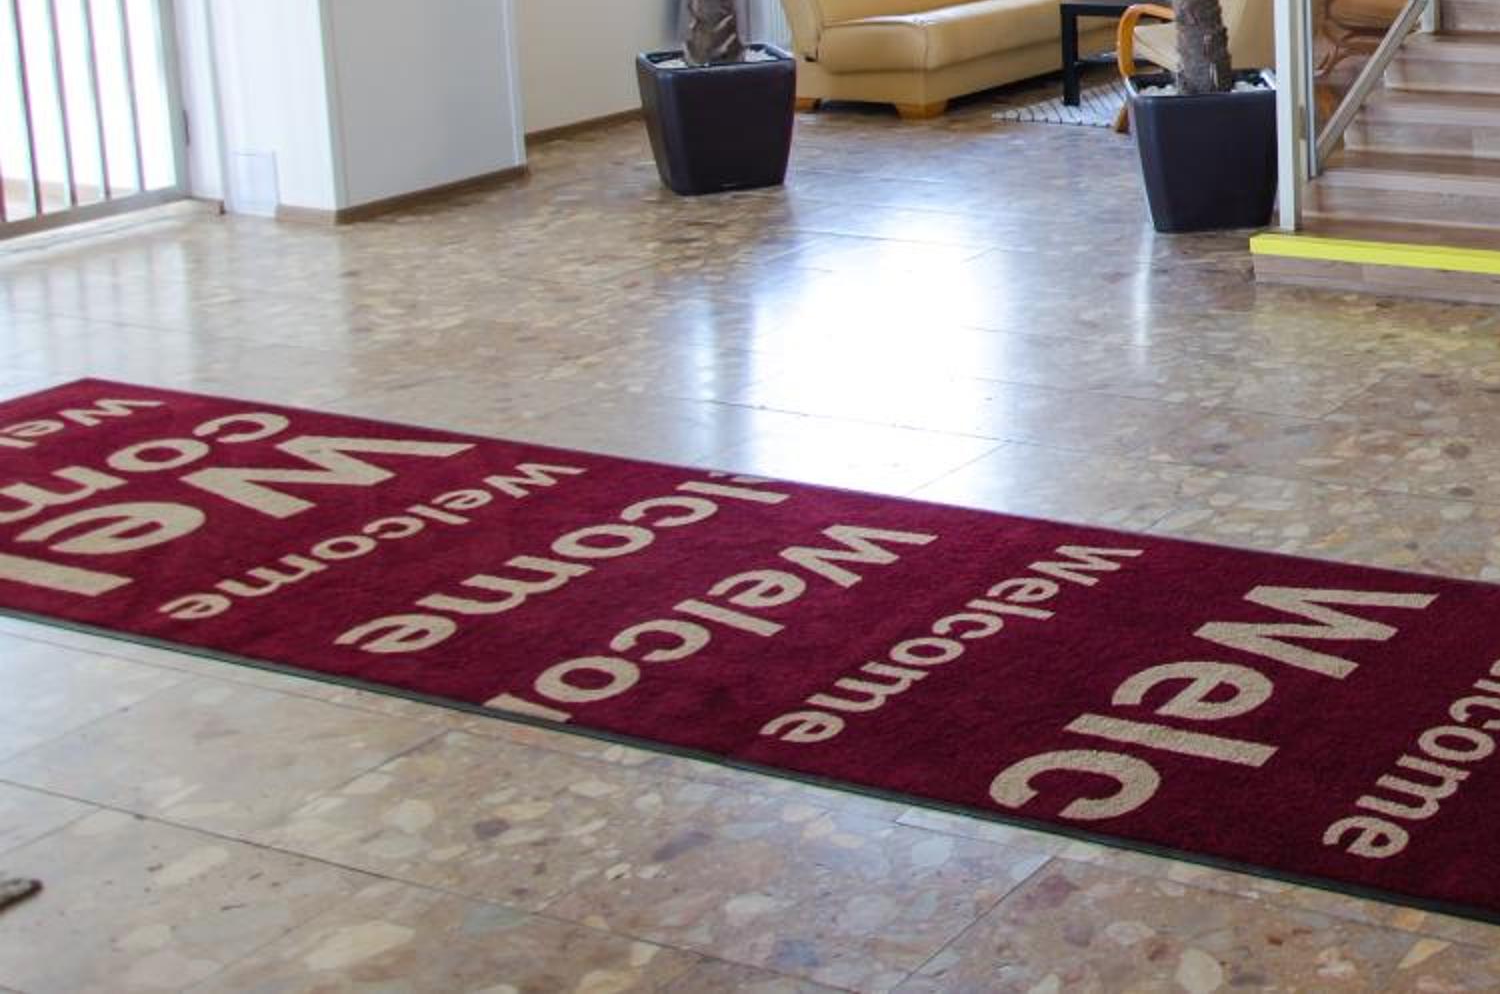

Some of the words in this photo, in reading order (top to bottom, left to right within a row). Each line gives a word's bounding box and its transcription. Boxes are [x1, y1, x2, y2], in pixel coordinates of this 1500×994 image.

[158, 463, 587, 619] Welcome
[335, 471, 791, 654] lcome
[760, 545, 1145, 744] Welcome
[988, 584, 1439, 820] Welc
